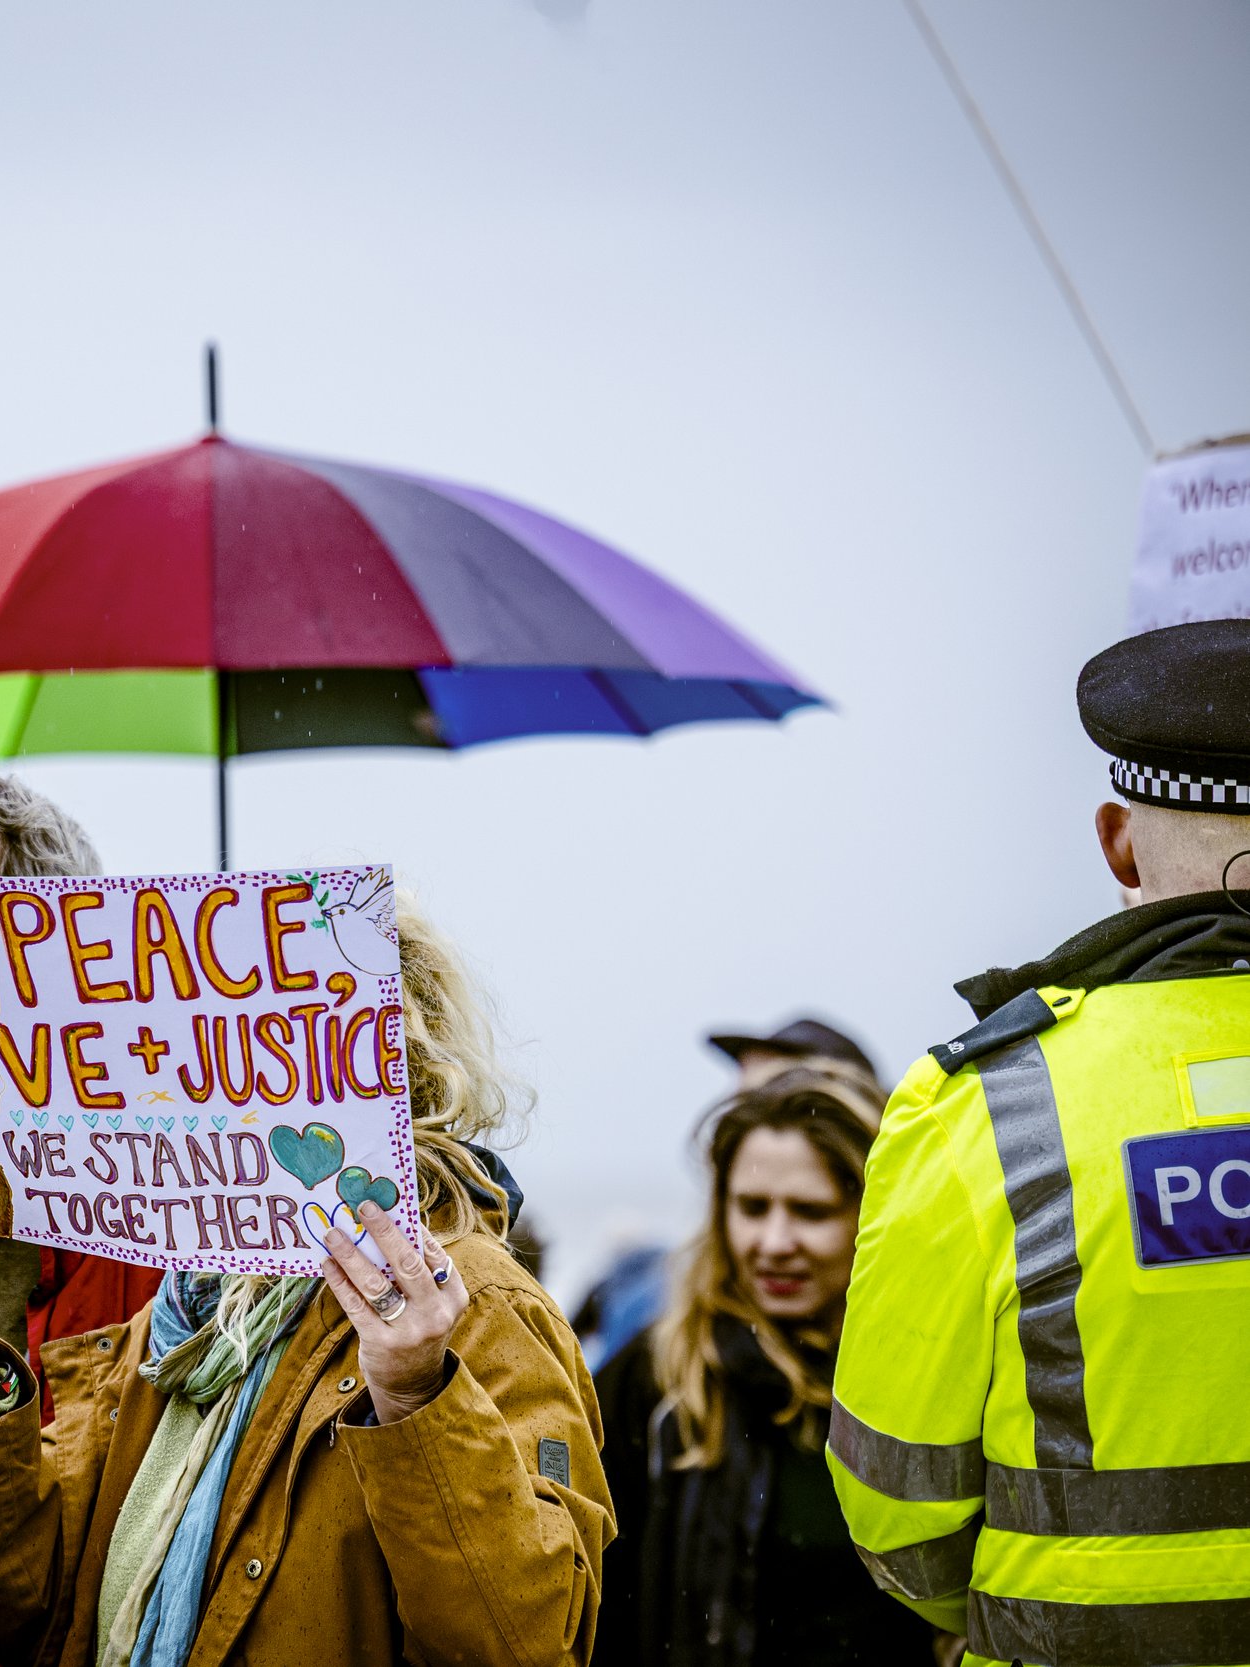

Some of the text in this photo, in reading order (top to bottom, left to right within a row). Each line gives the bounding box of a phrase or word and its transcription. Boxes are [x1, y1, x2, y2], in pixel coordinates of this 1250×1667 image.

[177, 1003, 407, 1103] JUSTICE
[2, 1131, 269, 1189] WE STAND
[26, 1190, 311, 1252] TOGETHER
[1154, 1159, 1250, 1227] PO
